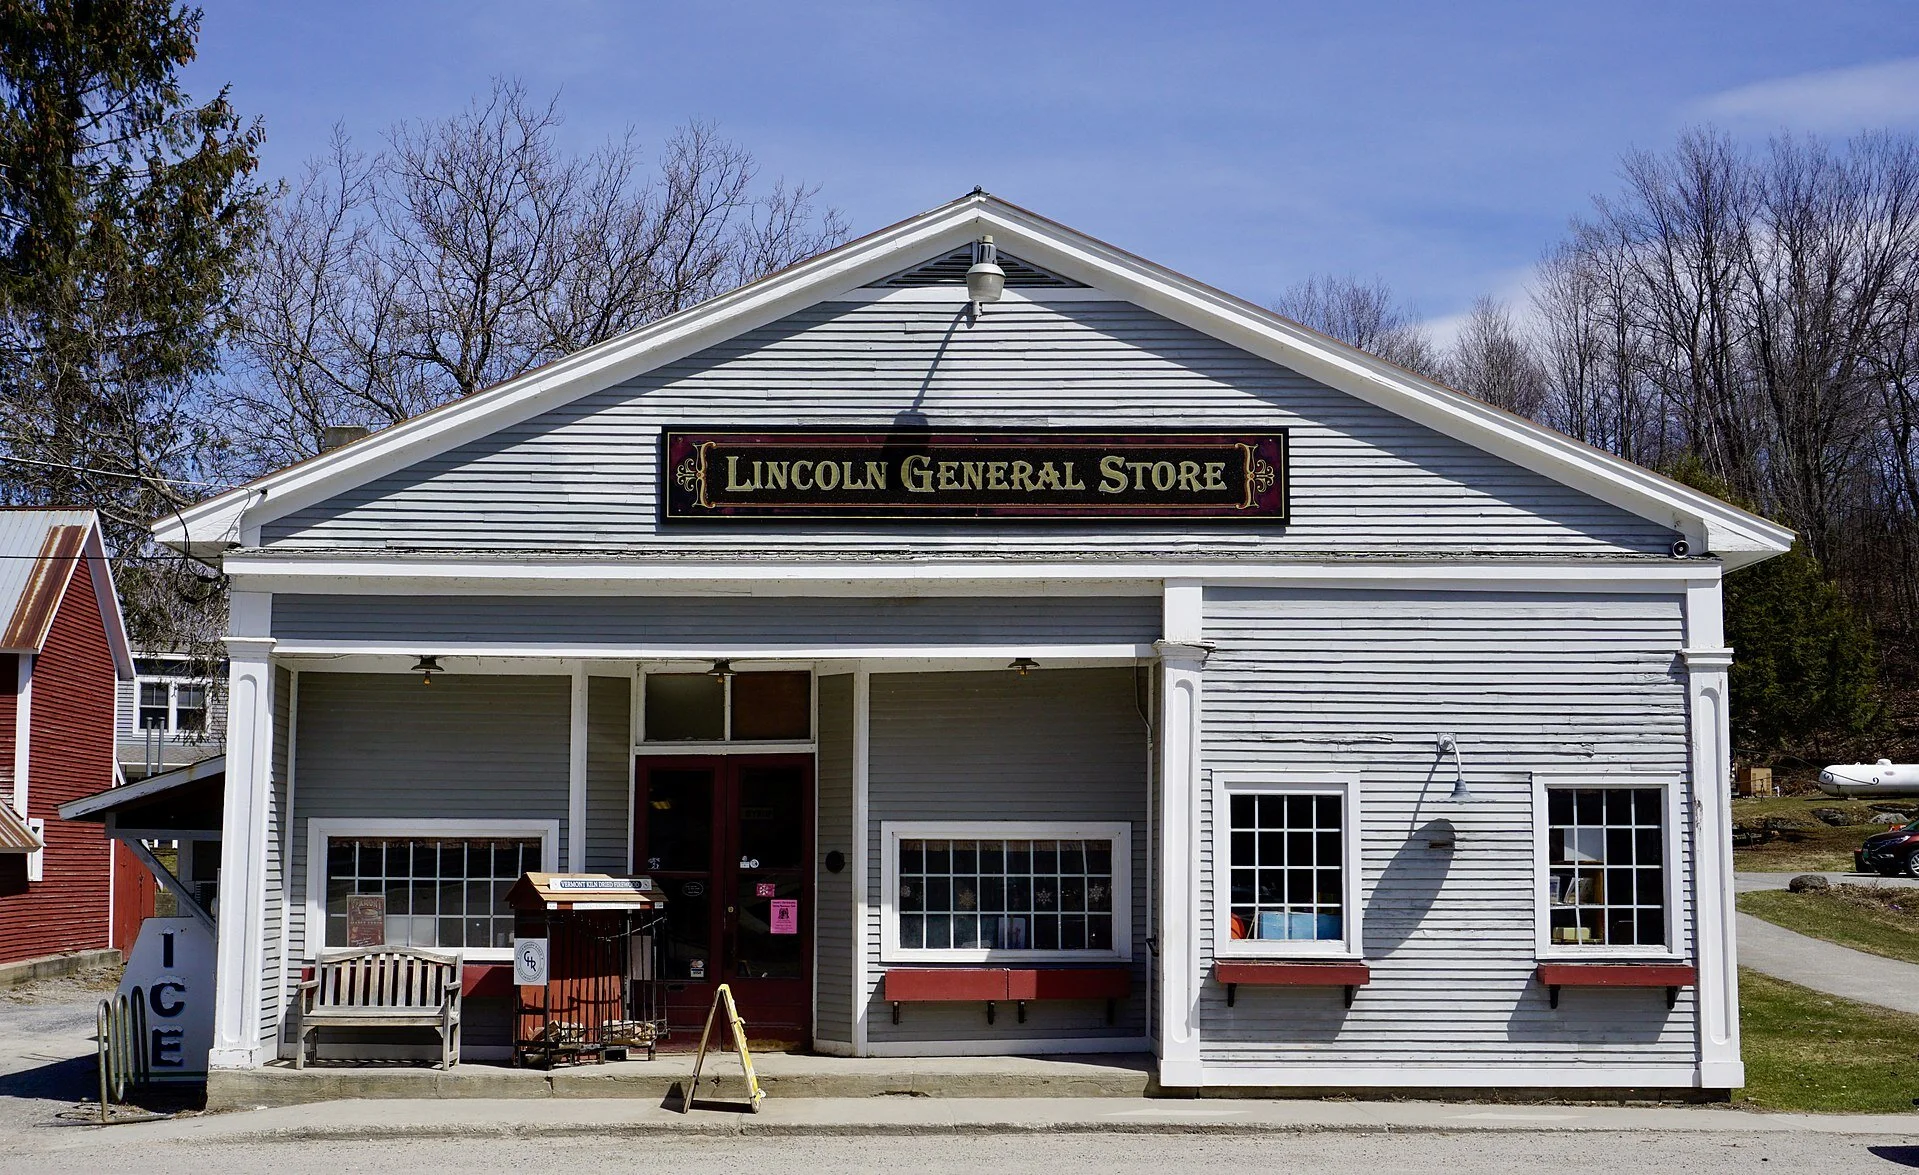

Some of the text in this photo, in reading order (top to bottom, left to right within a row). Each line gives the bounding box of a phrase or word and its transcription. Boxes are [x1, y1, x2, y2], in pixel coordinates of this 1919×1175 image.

[724, 455, 1227, 494] LINCOLN GENERAL STORE
[561, 881, 640, 889] VERMONT KILN DRIED FIREWOOD
[150, 926, 187, 1067] ICE
